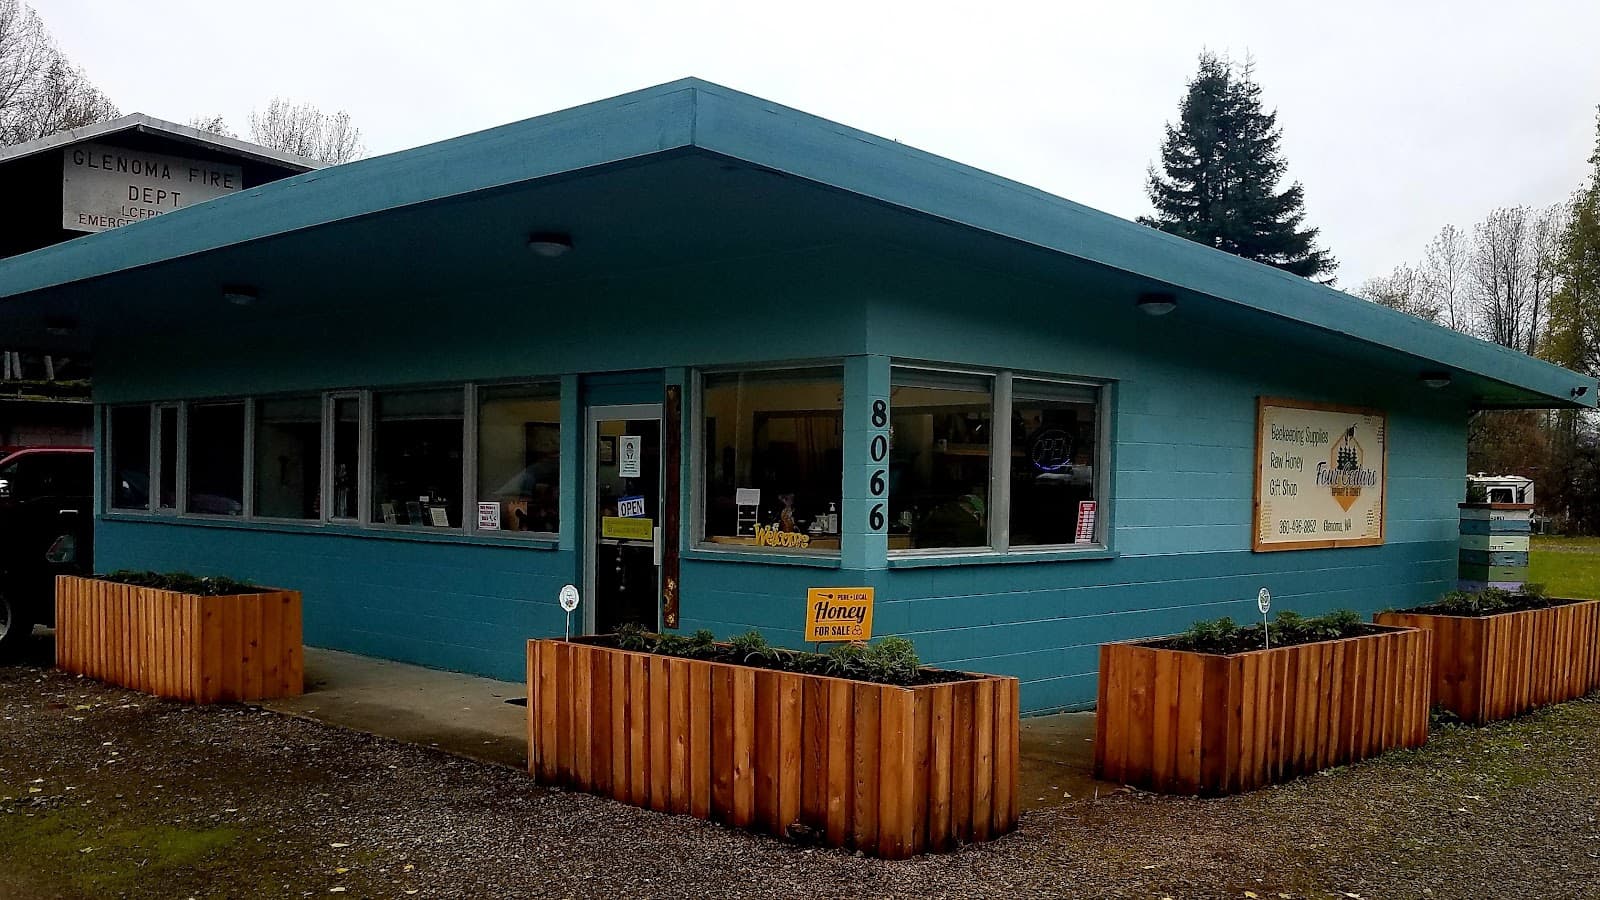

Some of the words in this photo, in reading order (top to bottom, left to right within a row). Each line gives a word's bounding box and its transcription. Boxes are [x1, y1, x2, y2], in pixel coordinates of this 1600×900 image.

[73, 150, 171, 180] GLENOMA
[189, 167, 234, 189] FIRE
[128, 185, 181, 207] DEPT
[1271, 423, 1304, 446] Beekeeping
[1305, 426, 1329, 447] Supplies
[869, 399, 887, 531] 8066
[1271, 451, 1284, 469] Raw
[1285, 451, 1304, 473] Honey
[1316, 461, 1340, 486] Four
[1341, 461, 1377, 486] Cedars
[1269, 479, 1281, 497] Gift
[1282, 479, 1298, 500] Shop
[621, 500, 644, 516] OPEN
[753, 522, 810, 548] Welcome
[814, 601, 867, 624] Honey
[814, 626, 830, 636] FOR
[831, 625, 851, 636] SALE
